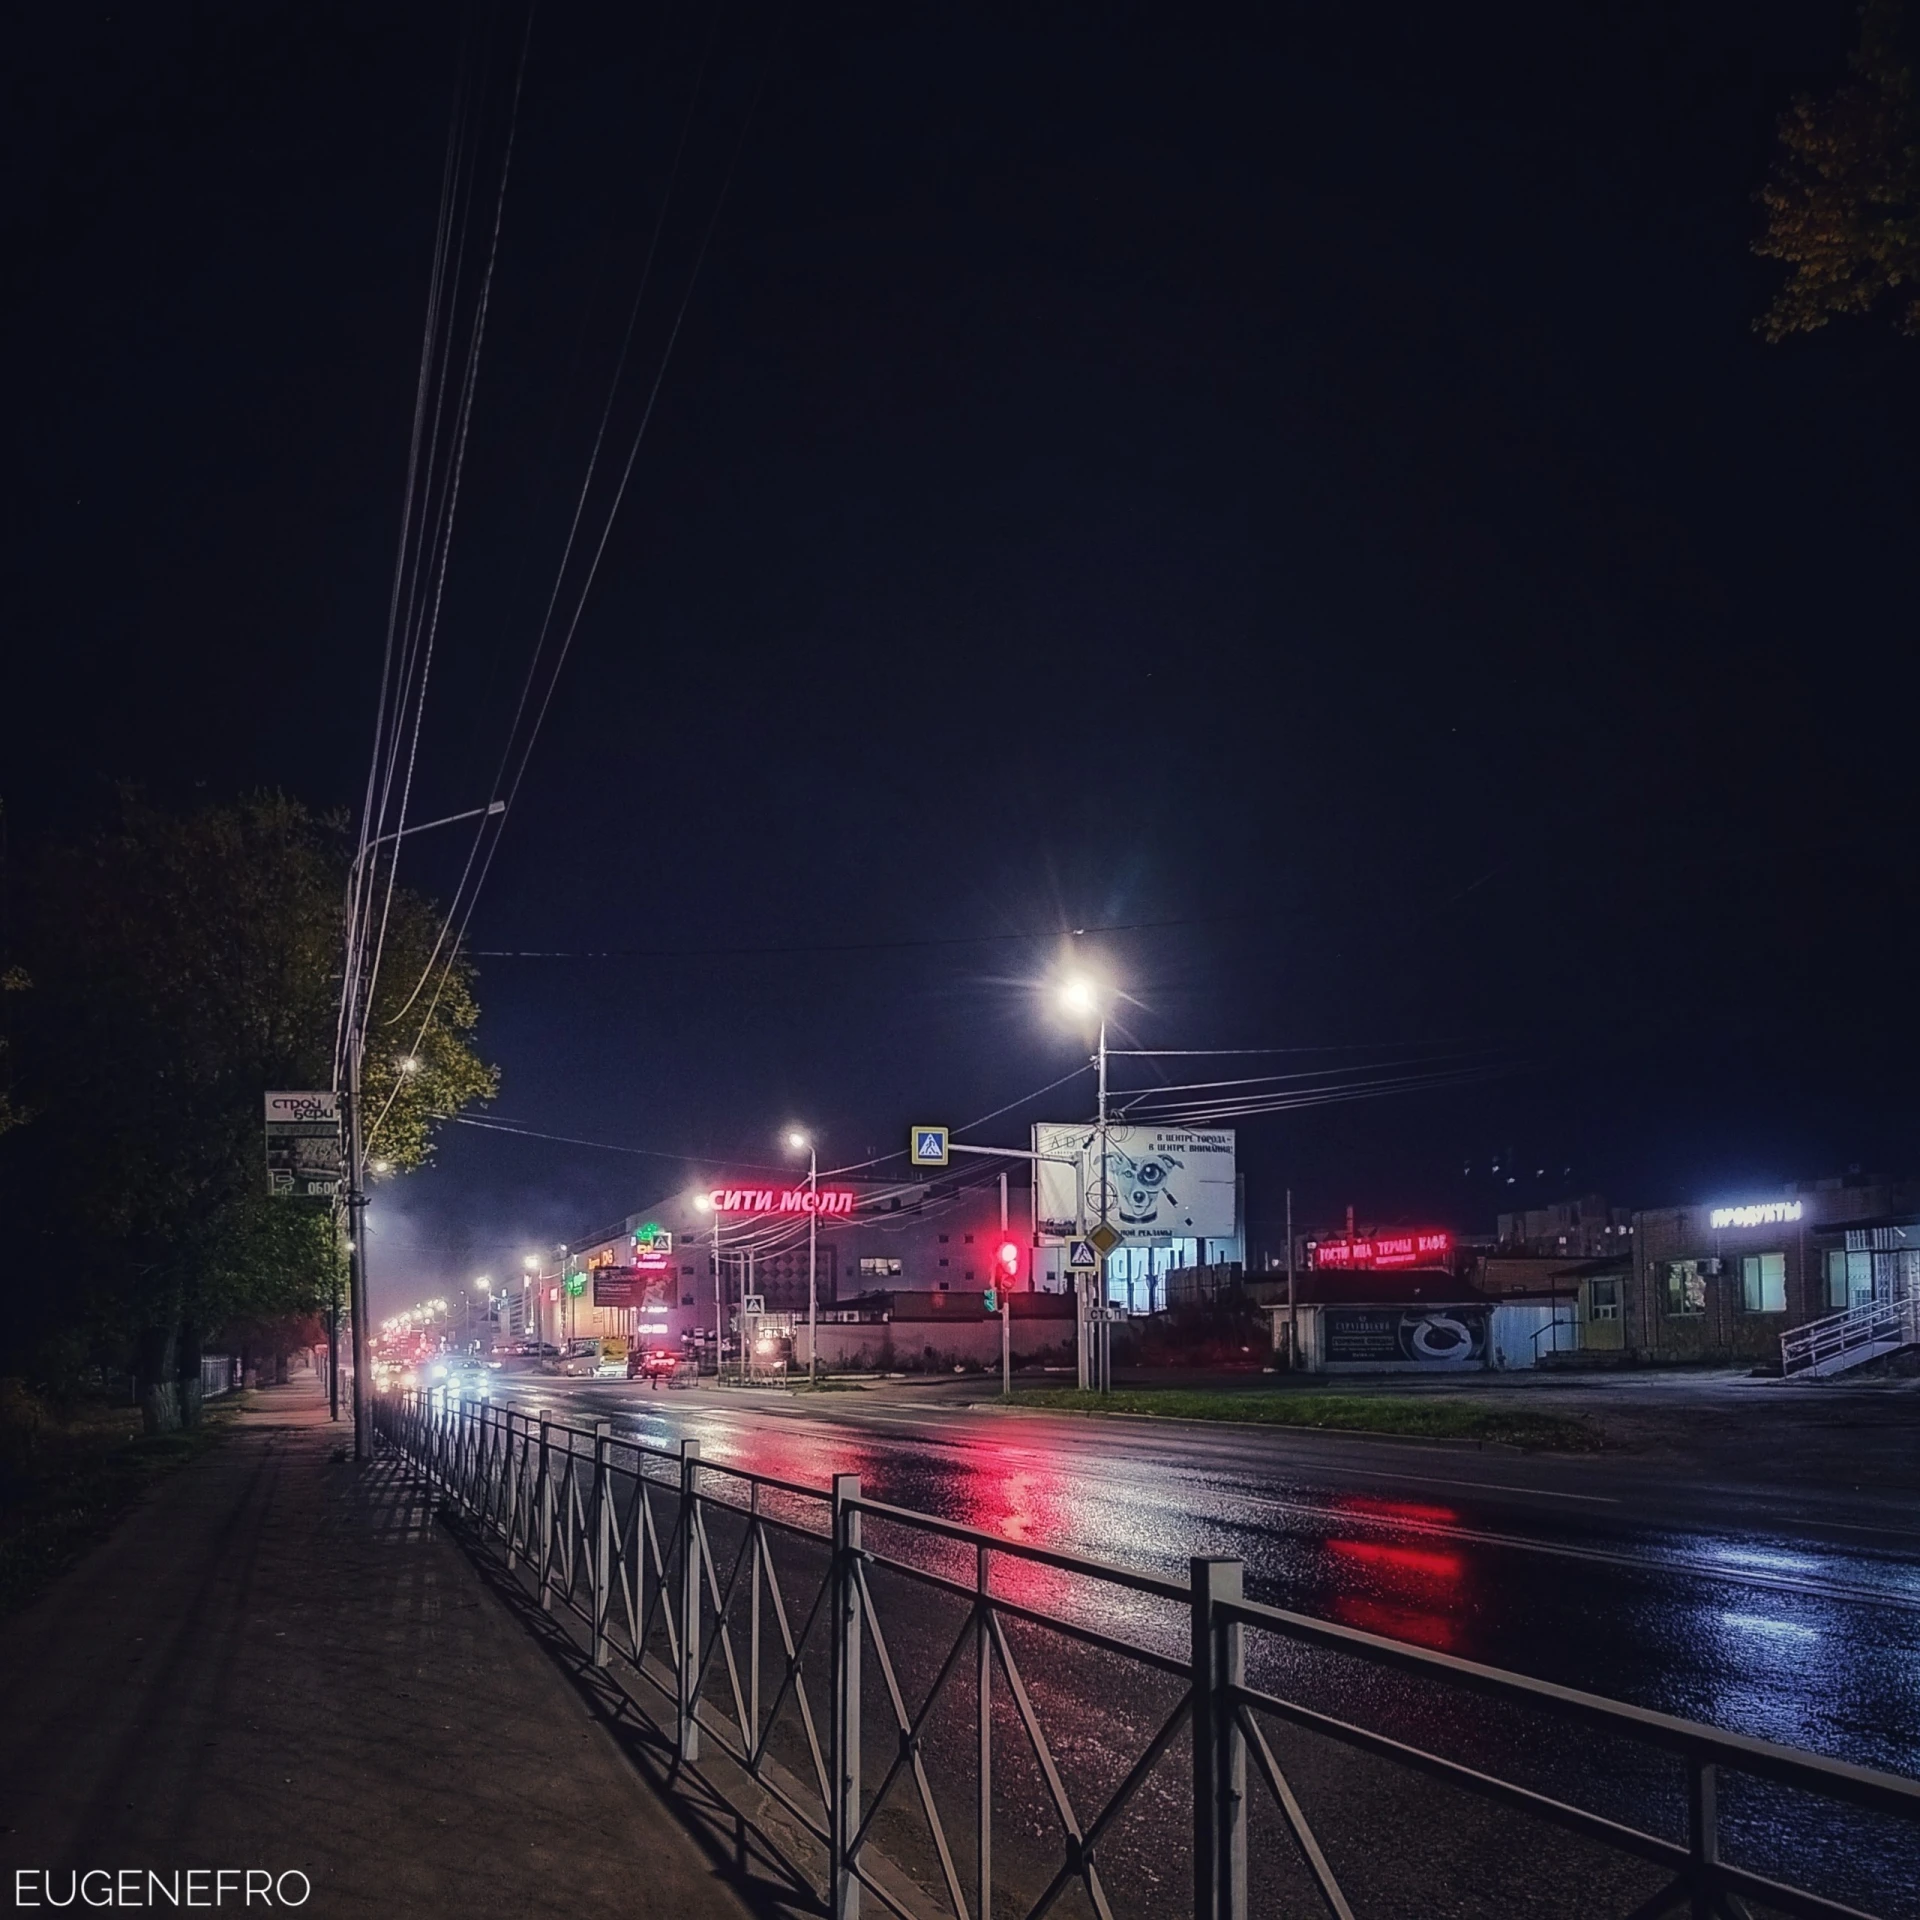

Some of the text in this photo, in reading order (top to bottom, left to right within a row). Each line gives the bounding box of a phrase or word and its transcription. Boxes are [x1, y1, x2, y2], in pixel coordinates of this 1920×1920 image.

[1165, 1134, 1193, 1142] ЦЕНТРЕ
[1197, 1135, 1226, 1143] ГОРОДА
[1157, 1144, 1186, 1152] ЦЕНТРЕ
[307, 1181, 339, 1195] ОБОИ
[708, 1189, 854, 1212] СИТИ МОЛЛ
[1710, 1201, 1803, 1229] ПРОДУКТЫ
[1418, 1235, 1447, 1251] КАФЕ
[1090, 1310, 1122, 1320] СТОП
